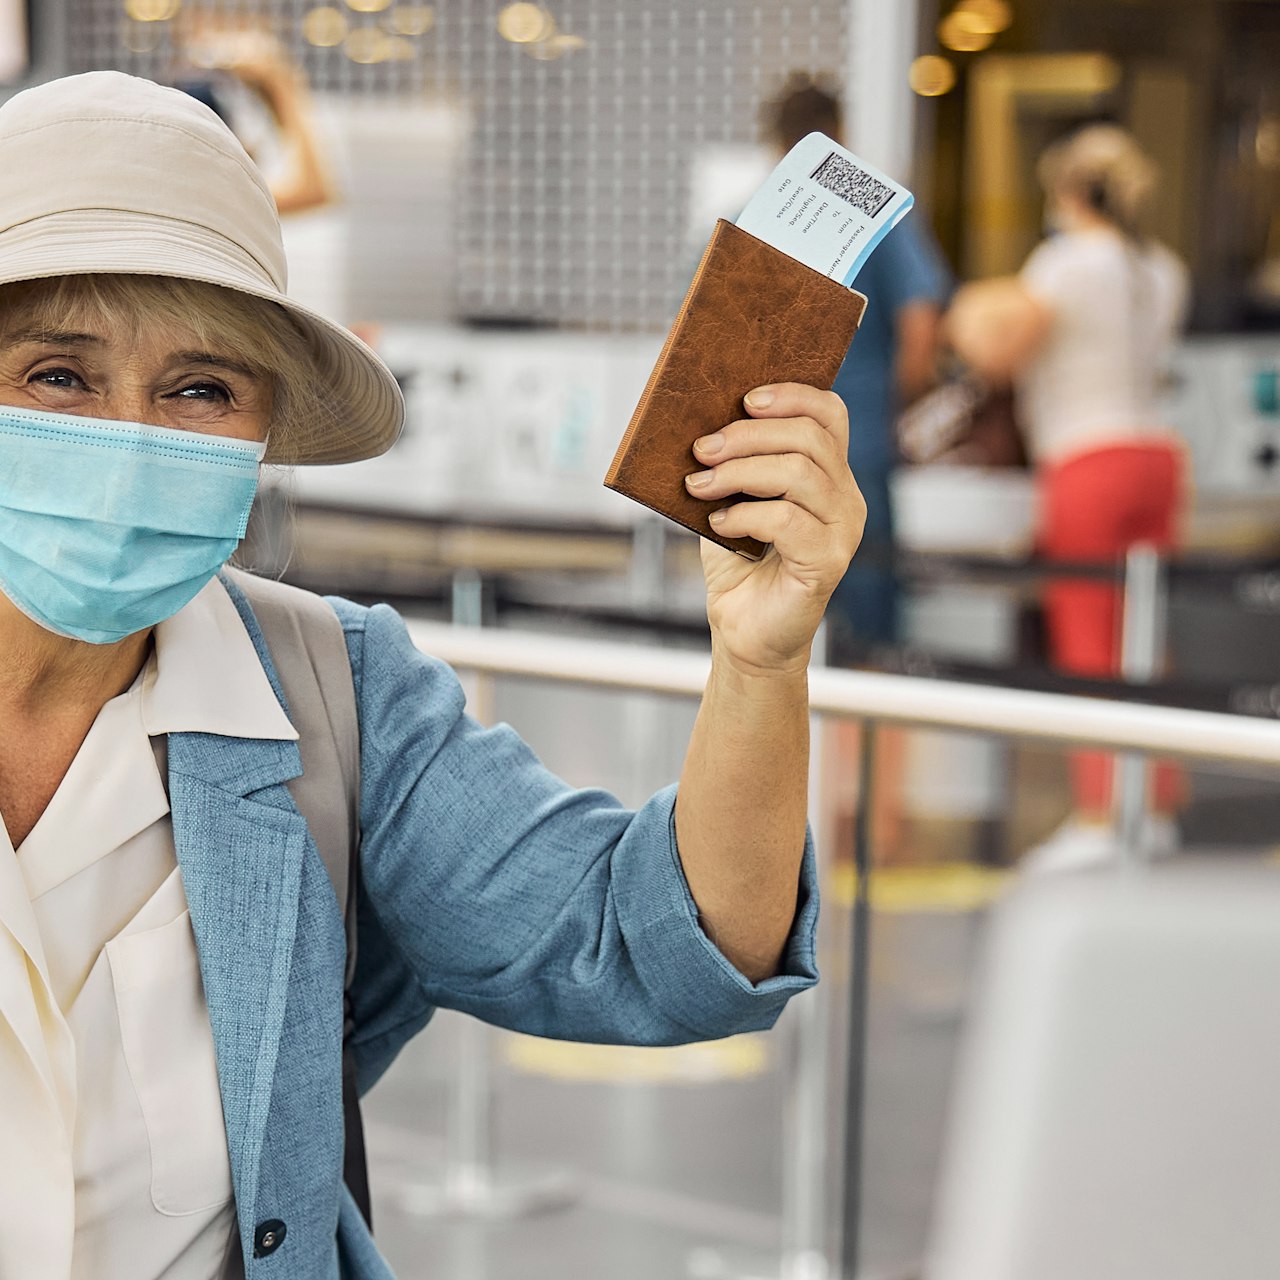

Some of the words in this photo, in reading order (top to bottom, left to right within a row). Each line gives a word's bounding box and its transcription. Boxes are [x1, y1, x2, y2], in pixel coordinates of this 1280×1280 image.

[776, 186, 804, 219] Seat/Class
[803, 202, 828, 234] Date/Time
[832, 210, 841, 218] To
[838, 218, 853, 234] From
[839, 225, 865, 258] Passenger
